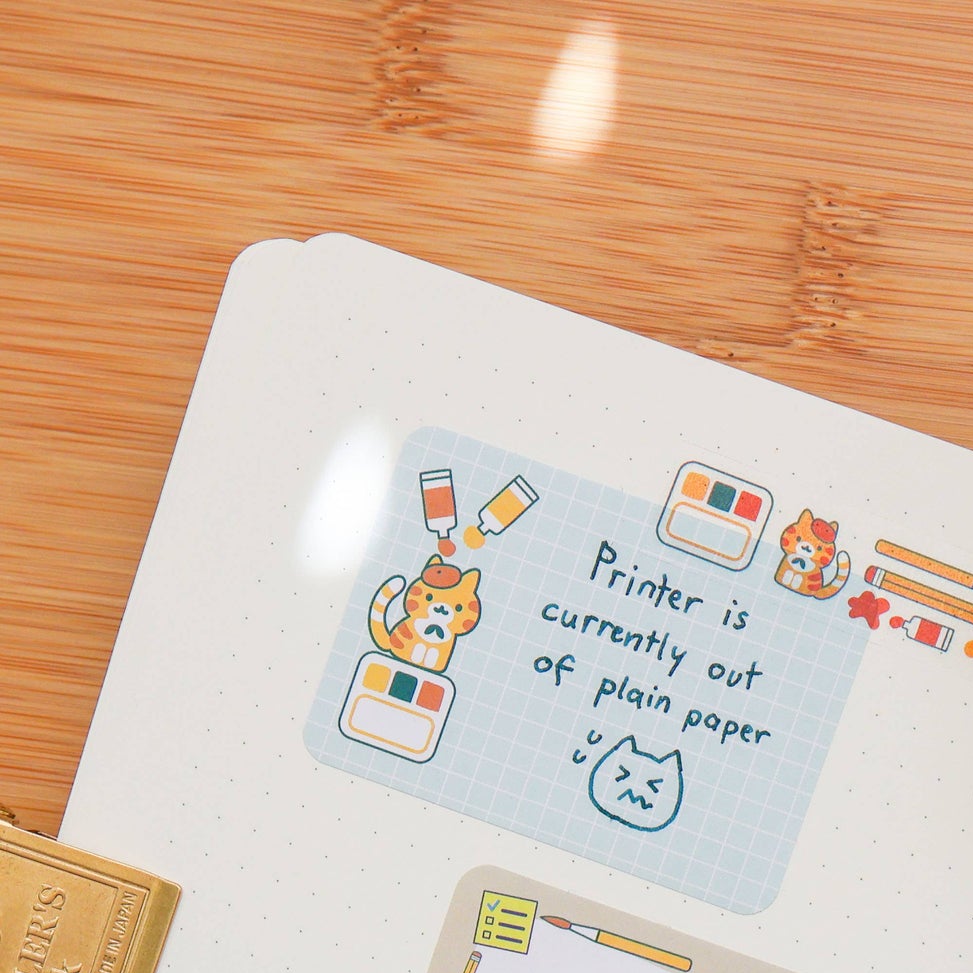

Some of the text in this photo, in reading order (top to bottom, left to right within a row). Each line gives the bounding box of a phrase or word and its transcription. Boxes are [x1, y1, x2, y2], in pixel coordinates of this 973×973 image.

[590, 540, 750, 630] Printer is
[541, 603, 763, 689] currently out
[533, 654, 771, 744] of plain paper
[106, 938, 122, 955] IN
[112, 890, 137, 937] JAPAN
